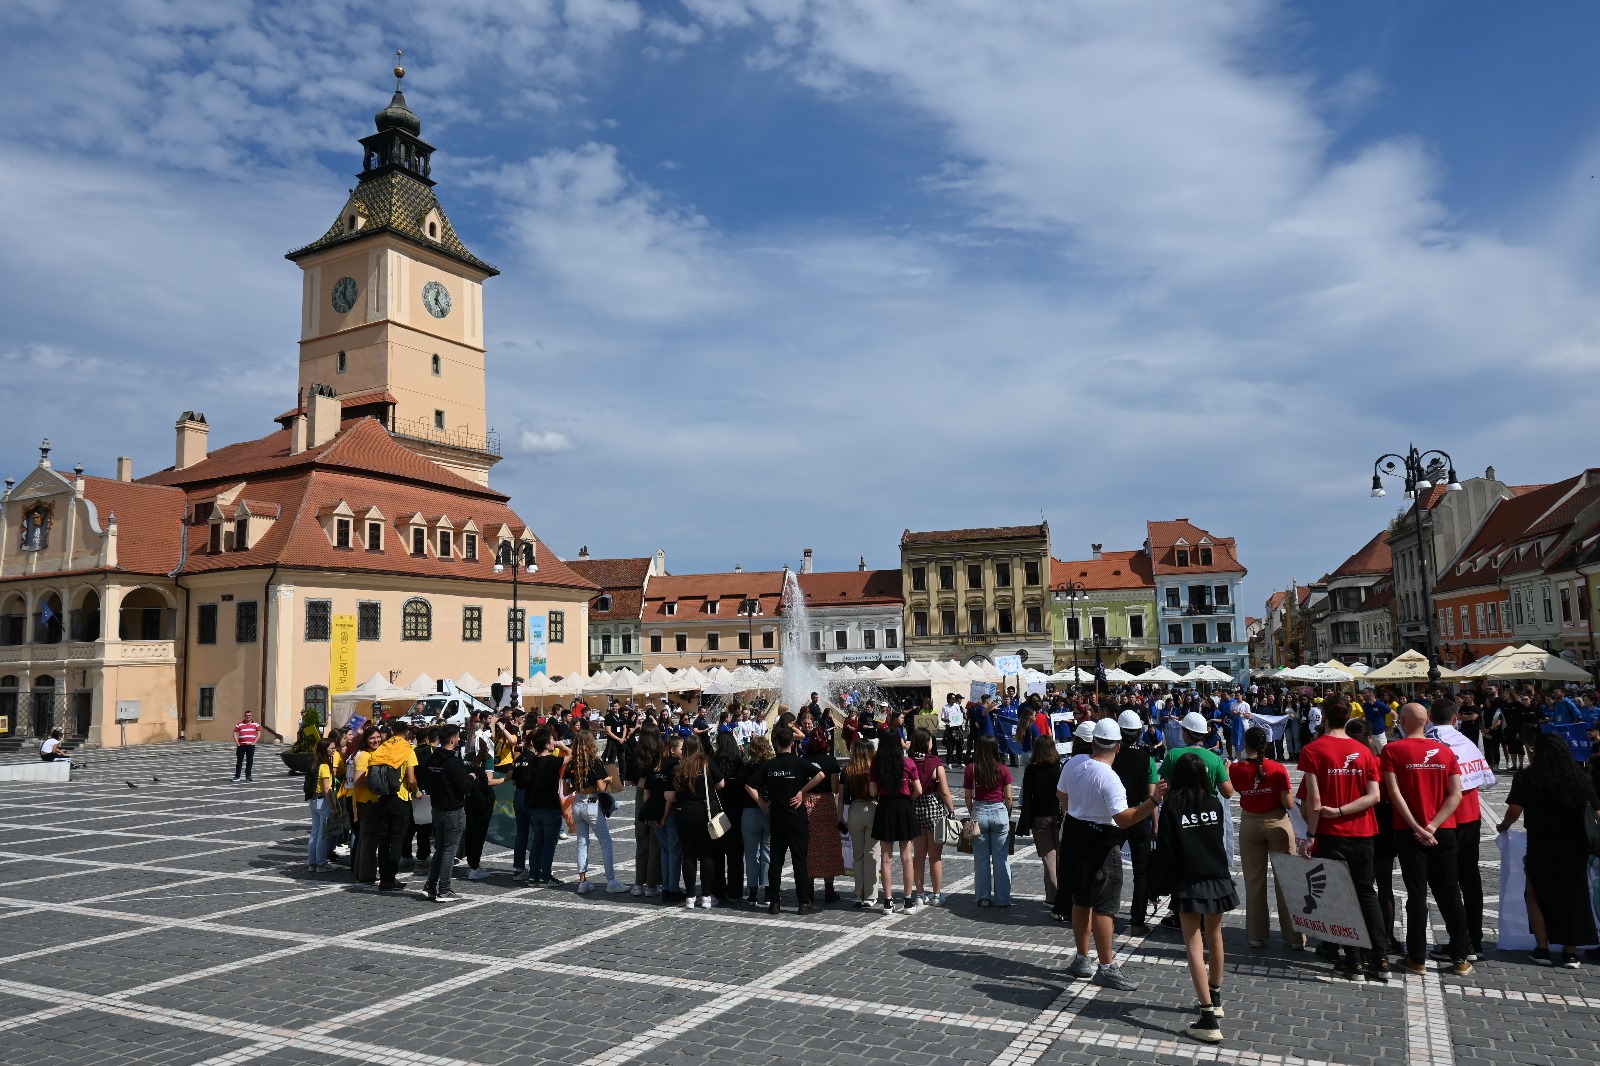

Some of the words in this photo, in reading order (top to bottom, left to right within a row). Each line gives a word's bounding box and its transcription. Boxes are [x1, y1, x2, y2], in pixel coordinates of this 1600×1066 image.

[1205, 645, 1228, 654] Bank
[339, 646, 349, 685] OLIMPIA
[1181, 810, 1218, 825] ASCB
[1292, 914, 1328, 934] SOCIETATEA
[1329, 924, 1360, 941] HERMES
